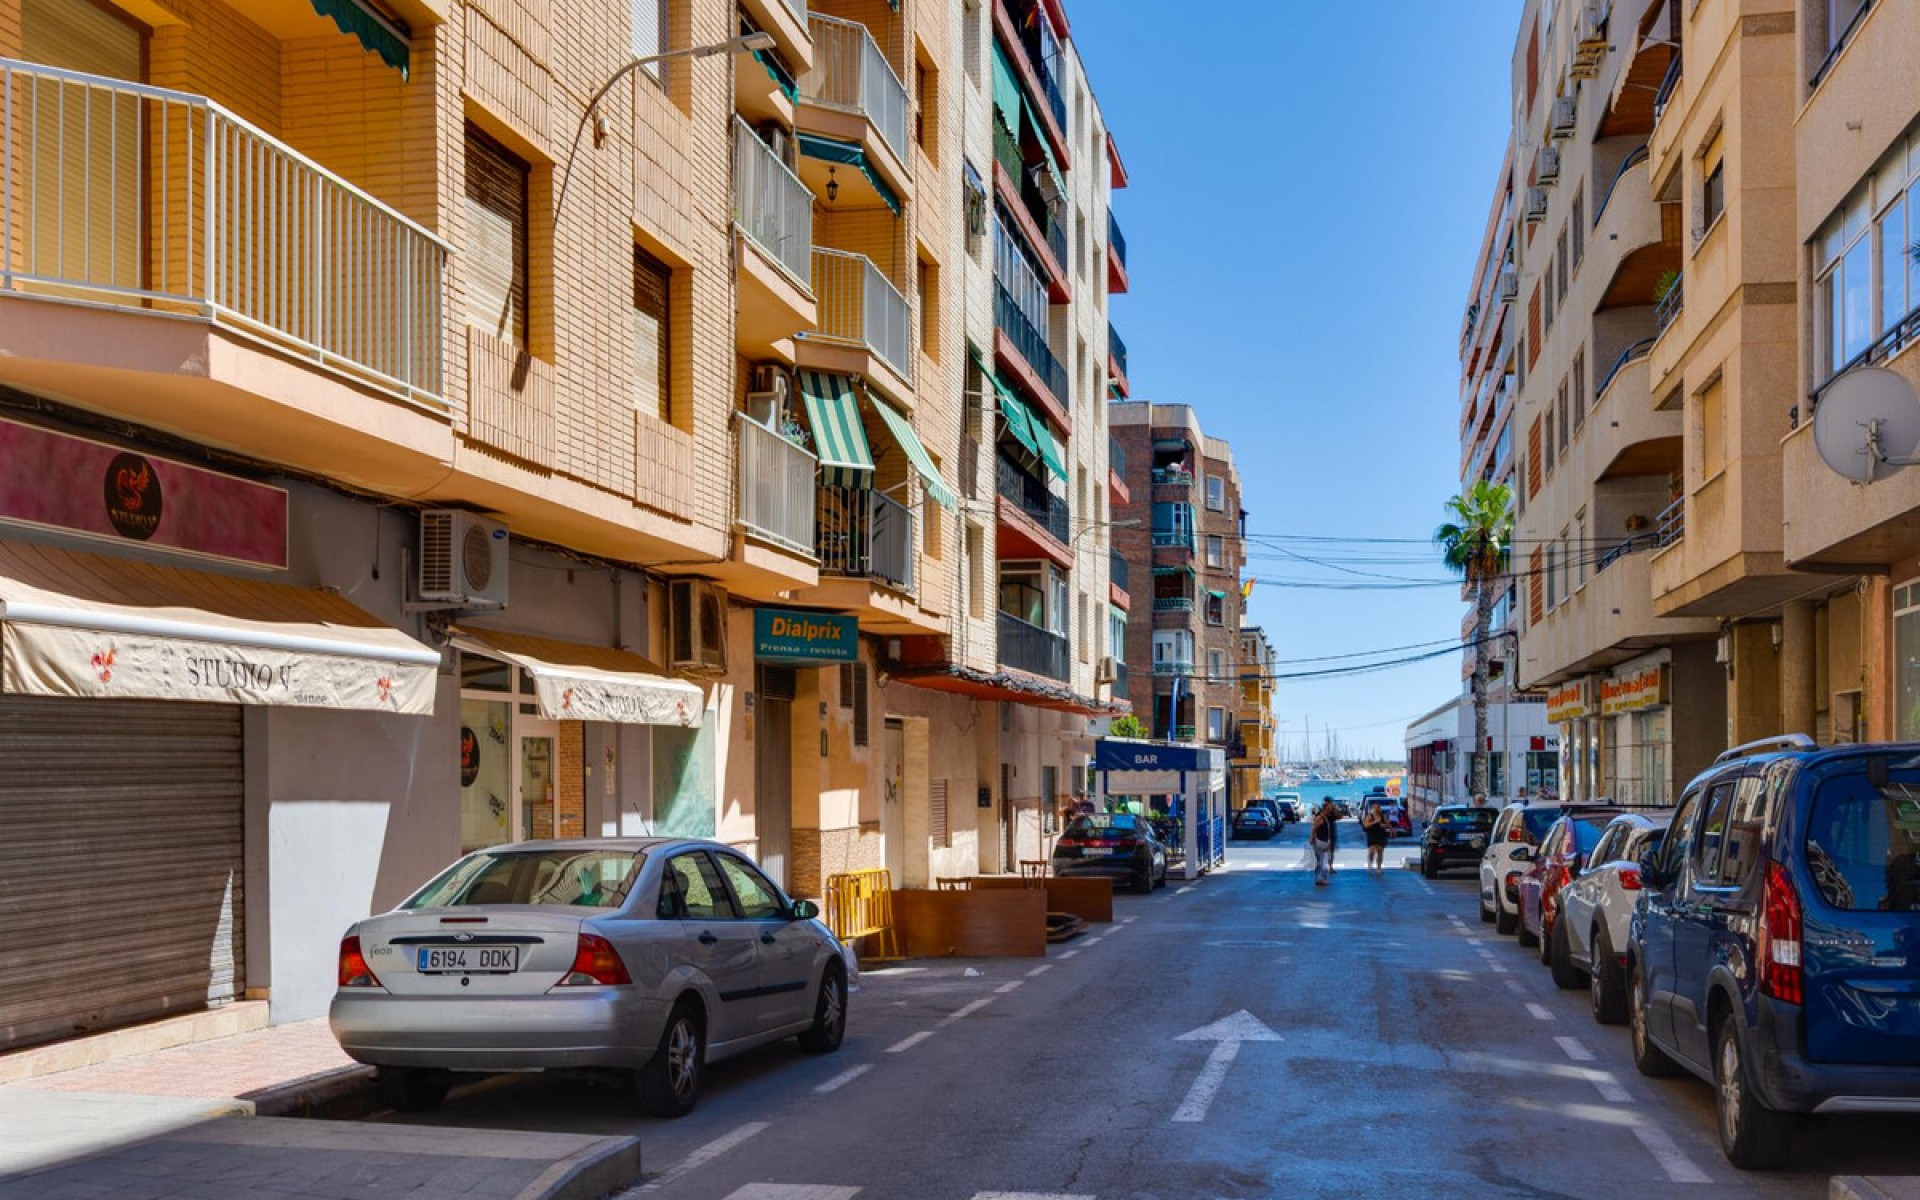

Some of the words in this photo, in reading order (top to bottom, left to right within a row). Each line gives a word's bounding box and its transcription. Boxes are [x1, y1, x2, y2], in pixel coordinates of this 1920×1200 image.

[771, 615, 842, 642] Dialprix
[760, 642, 801, 653] Prensa
[186, 656, 274, 692] STUDIO
[1135, 754, 1158, 764] BAR
[431, 950, 467, 967] 6194
[480, 950, 511, 967] DDK
